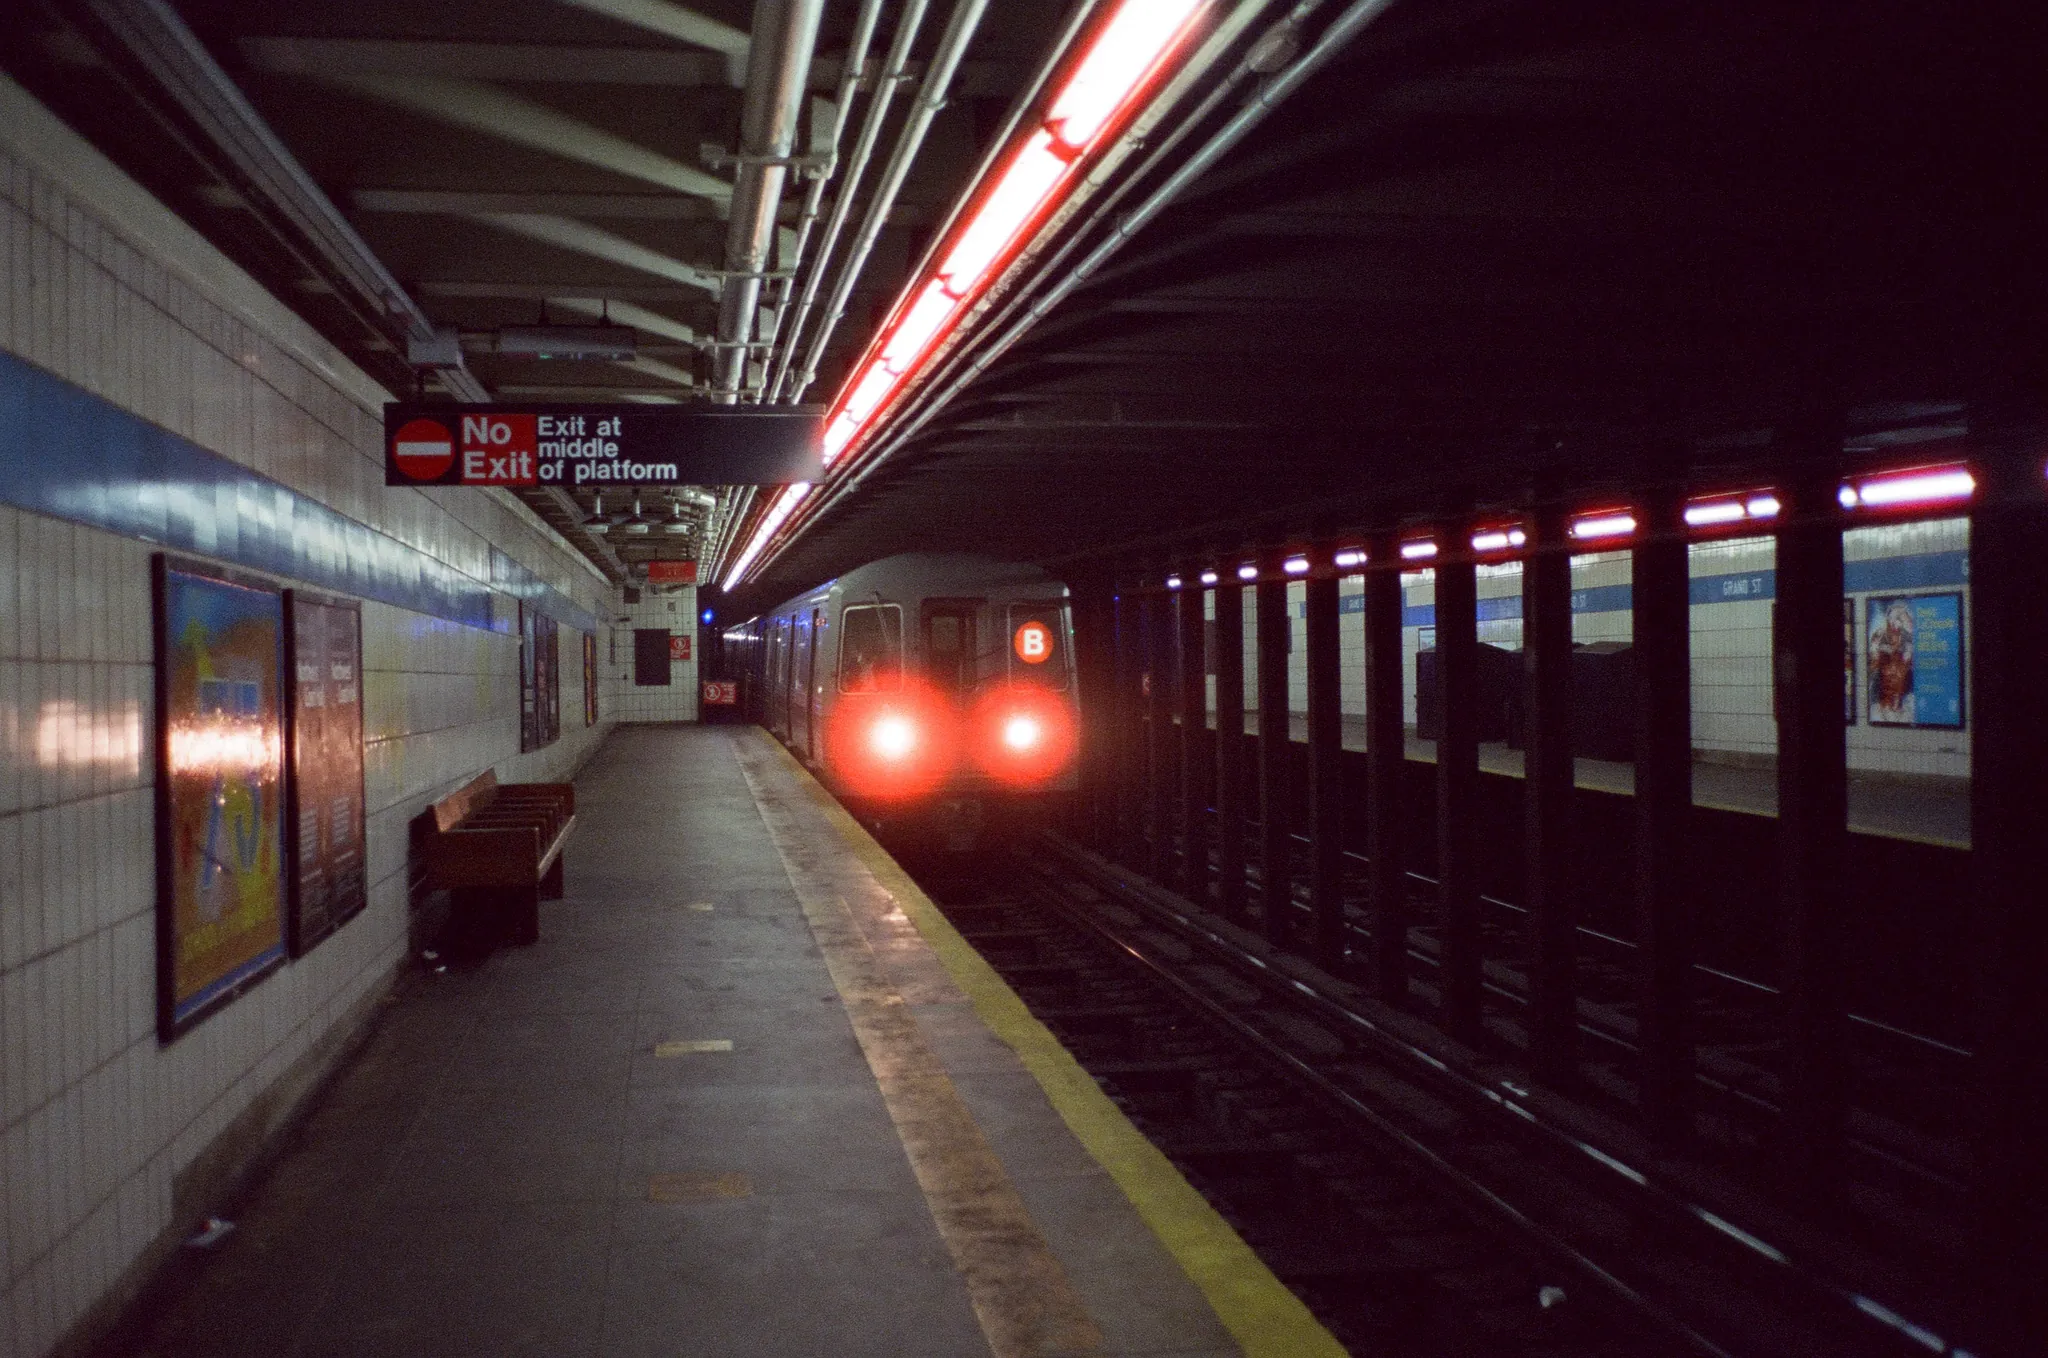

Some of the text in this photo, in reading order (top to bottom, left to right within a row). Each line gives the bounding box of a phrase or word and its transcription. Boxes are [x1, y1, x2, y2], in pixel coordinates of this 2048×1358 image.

[463, 416, 512, 445] No
[537, 416, 622, 436] Exit at
[538, 438, 619, 458] middle
[463, 451, 532, 480] Exit
[538, 460, 677, 484] of platform
[1723, 578, 1762, 596] GRAND ST
[1024, 629, 1044, 655] B
